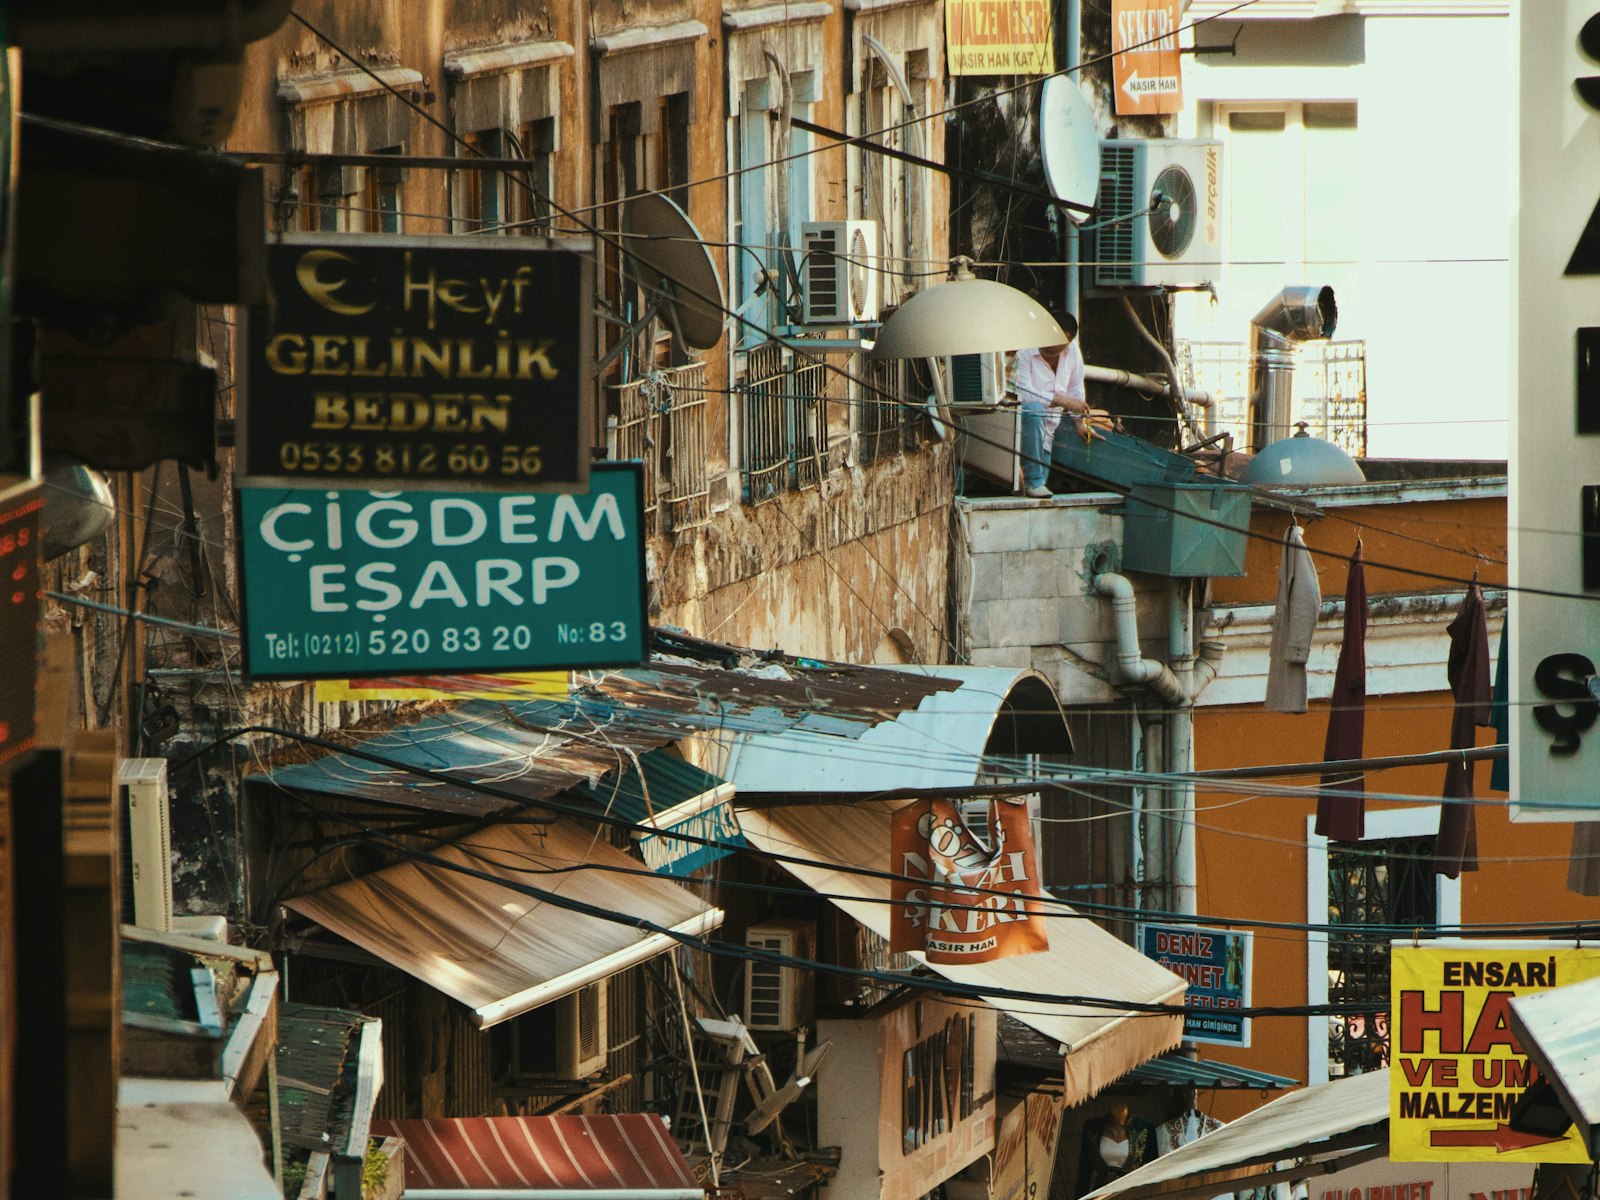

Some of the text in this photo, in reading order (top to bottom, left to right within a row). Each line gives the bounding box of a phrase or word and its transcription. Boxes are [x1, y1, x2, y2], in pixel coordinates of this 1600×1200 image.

[953, 52, 984, 68] NASIR
[988, 52, 1010, 67] HAN
[1014, 51, 1034, 67] KAT
[1130, 79, 1176, 92] NASIR HAN
[1207, 147, 1218, 220] arçelik
[265, 326, 558, 382] GELİNLİK
[311, 391, 513, 433] BEDEN
[280, 442, 542, 476] 0533 812 60 56
[260, 490, 626, 563] ÇİĞDEM
[309, 556, 580, 623] EŞARP
[265, 621, 626, 660] Tel: (0212) 520 83 20 No: 83
[928, 939, 994, 952] ASIR HAN
[1156, 932, 1213, 959] DENİZ
[1443, 956, 1556, 987] ENSARİ
[1186, 1019, 1238, 1033] HAN GİRİŞİNDE
[1400, 990, 1529, 1055] HA
[1399, 1059, 1536, 1088] VE UM
[1399, 1092, 1523, 1120] MALZEM
